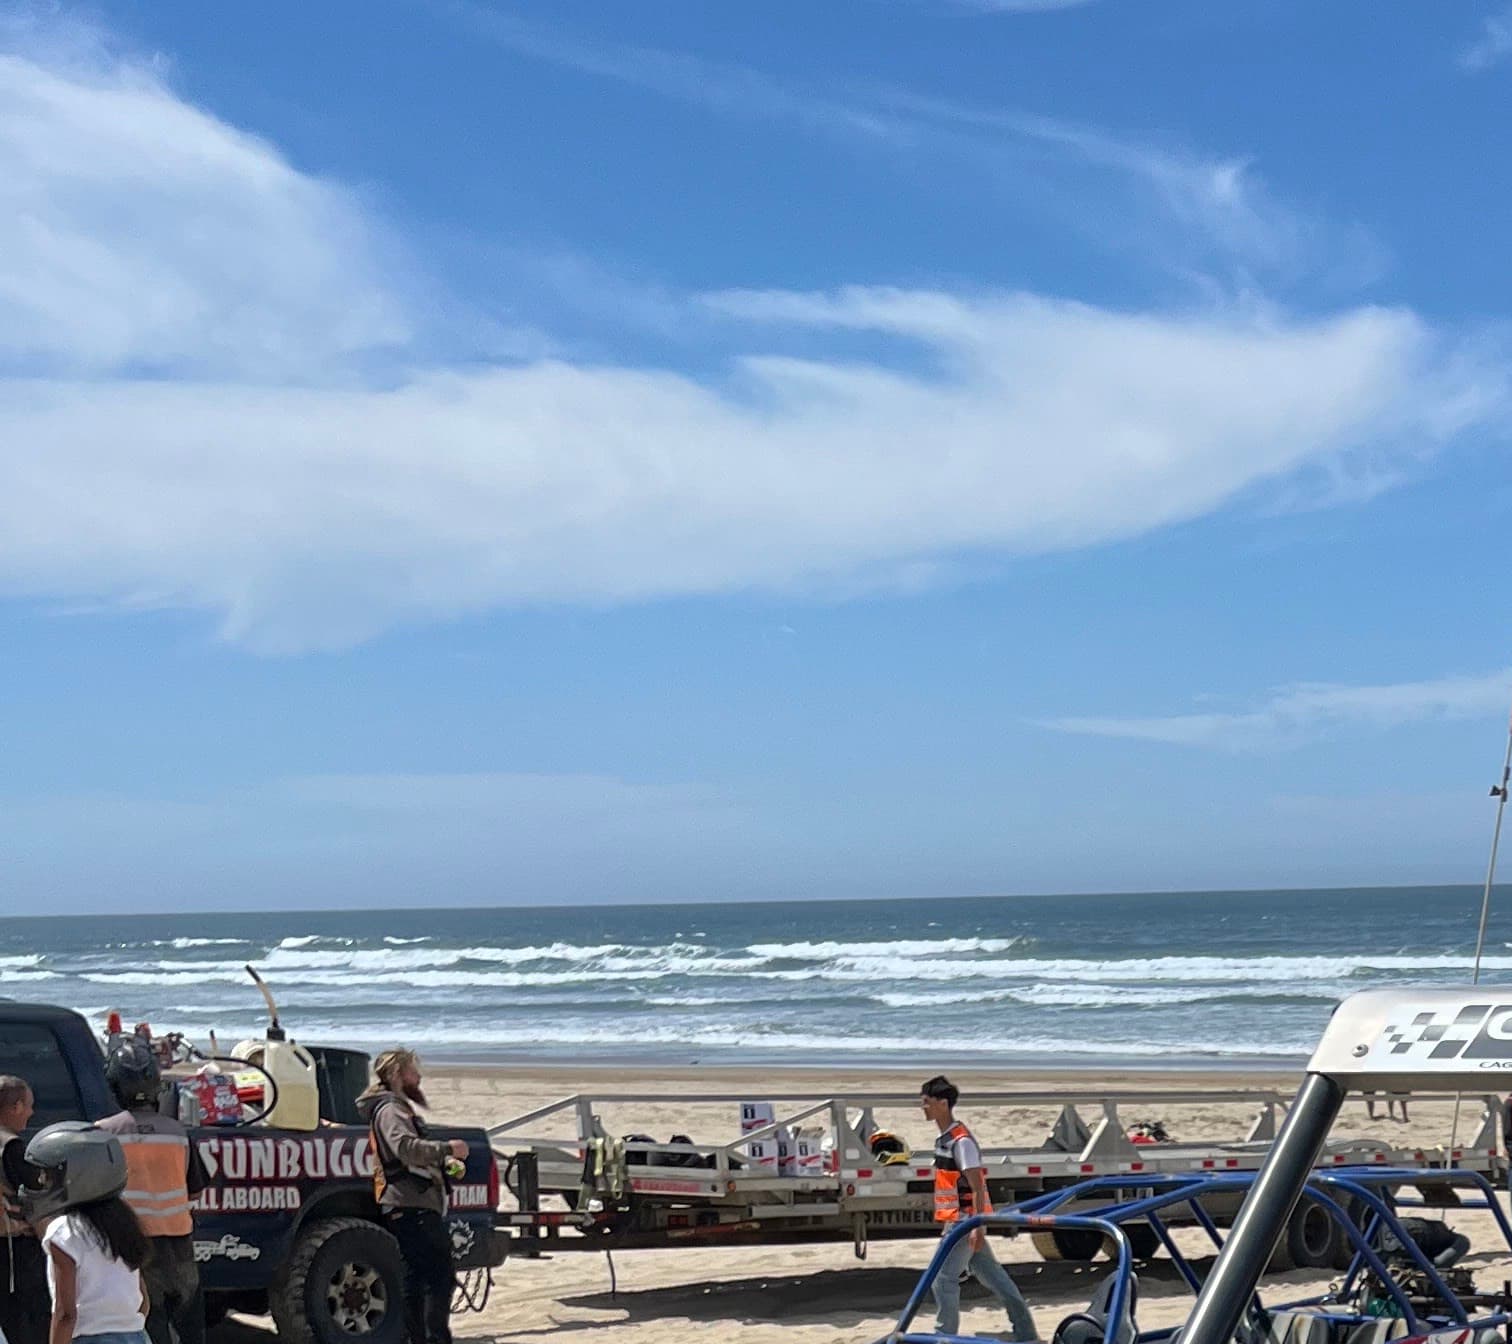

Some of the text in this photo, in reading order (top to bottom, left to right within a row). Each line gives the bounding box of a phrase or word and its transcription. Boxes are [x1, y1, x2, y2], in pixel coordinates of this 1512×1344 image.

[198, 1137, 375, 1180] SUNBUGG
[222, 1186, 300, 1210] ABOARD
[452, 1184, 488, 1207] TRAM
